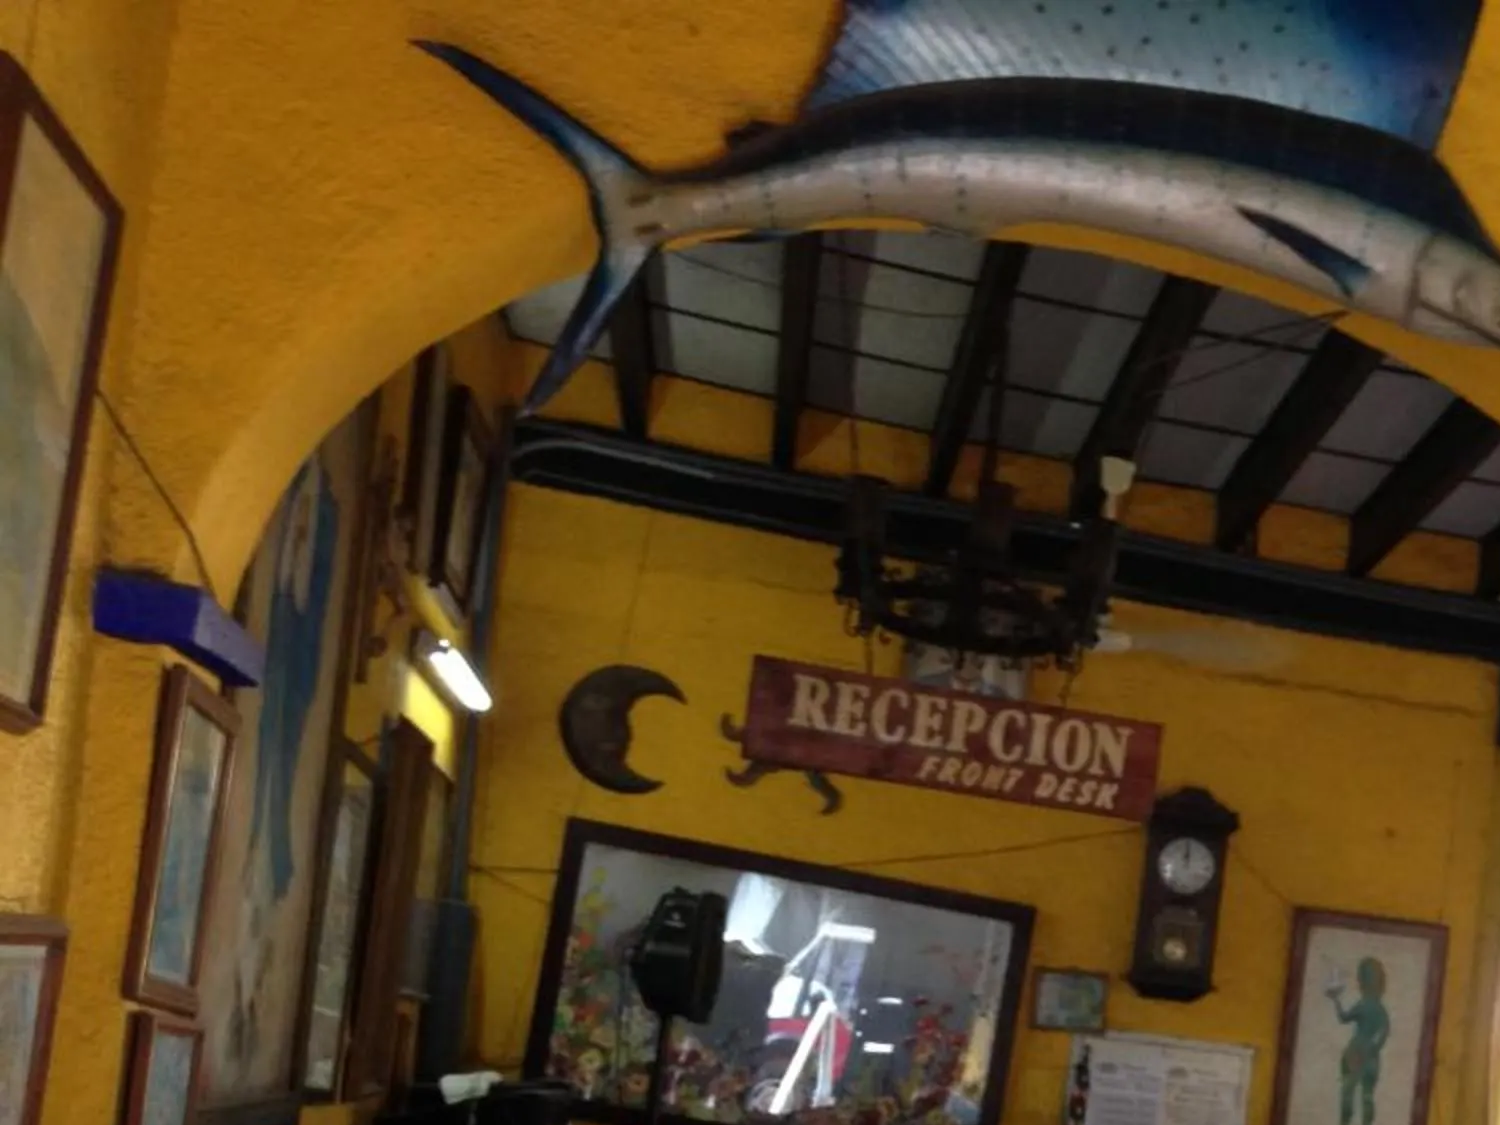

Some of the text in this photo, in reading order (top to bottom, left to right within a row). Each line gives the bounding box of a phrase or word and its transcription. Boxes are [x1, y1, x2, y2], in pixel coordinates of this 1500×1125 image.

[788, 673, 1135, 778] RECEPCION
[917, 755, 1119, 812] FRONT DESK
